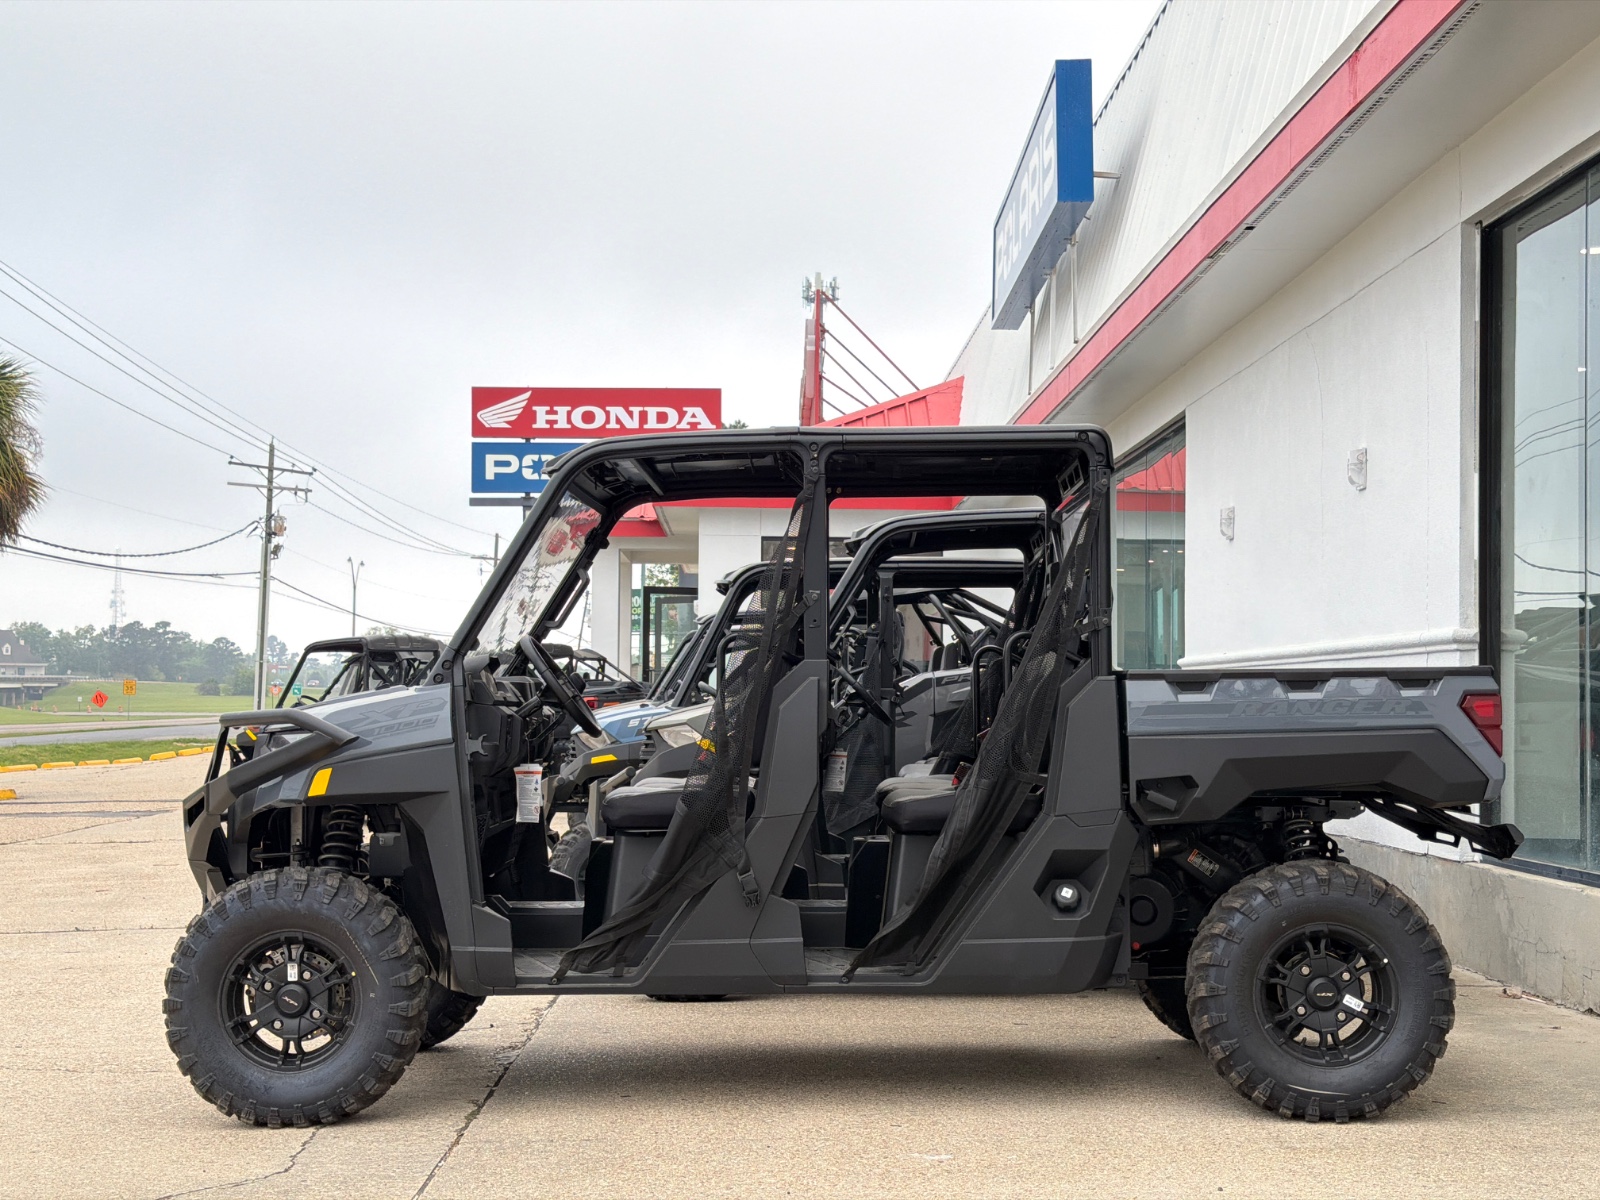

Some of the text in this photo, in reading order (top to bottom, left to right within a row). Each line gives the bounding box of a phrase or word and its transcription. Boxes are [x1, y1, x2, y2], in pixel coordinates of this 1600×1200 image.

[531, 405, 716, 430] HONDA
[352, 697, 447, 728] XP
[1230, 699, 1416, 717] RANGER
[373, 714, 439, 736] 1000
